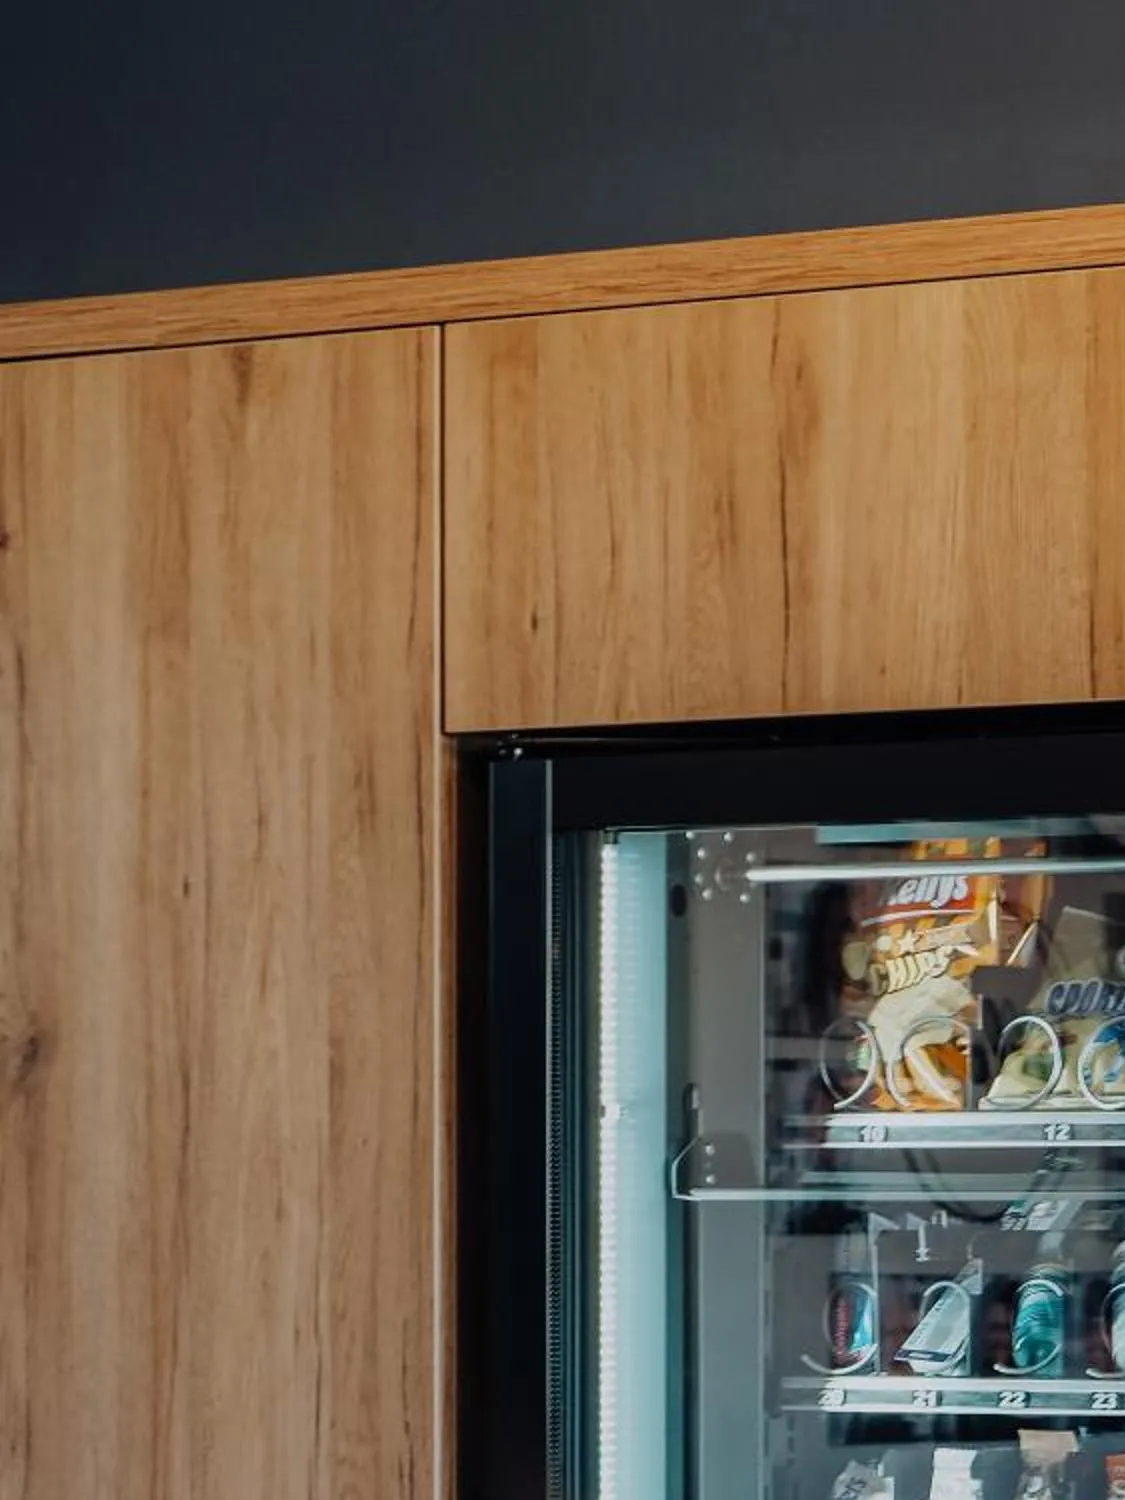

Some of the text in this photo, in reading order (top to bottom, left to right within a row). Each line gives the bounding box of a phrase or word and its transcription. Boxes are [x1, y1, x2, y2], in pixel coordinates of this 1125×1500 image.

[1044, 1123, 1071, 1141] 12
[912, 1390, 937, 1408] 21
[999, 1391, 1026, 1408] 22
[1092, 1393, 1118, 1410] 23
